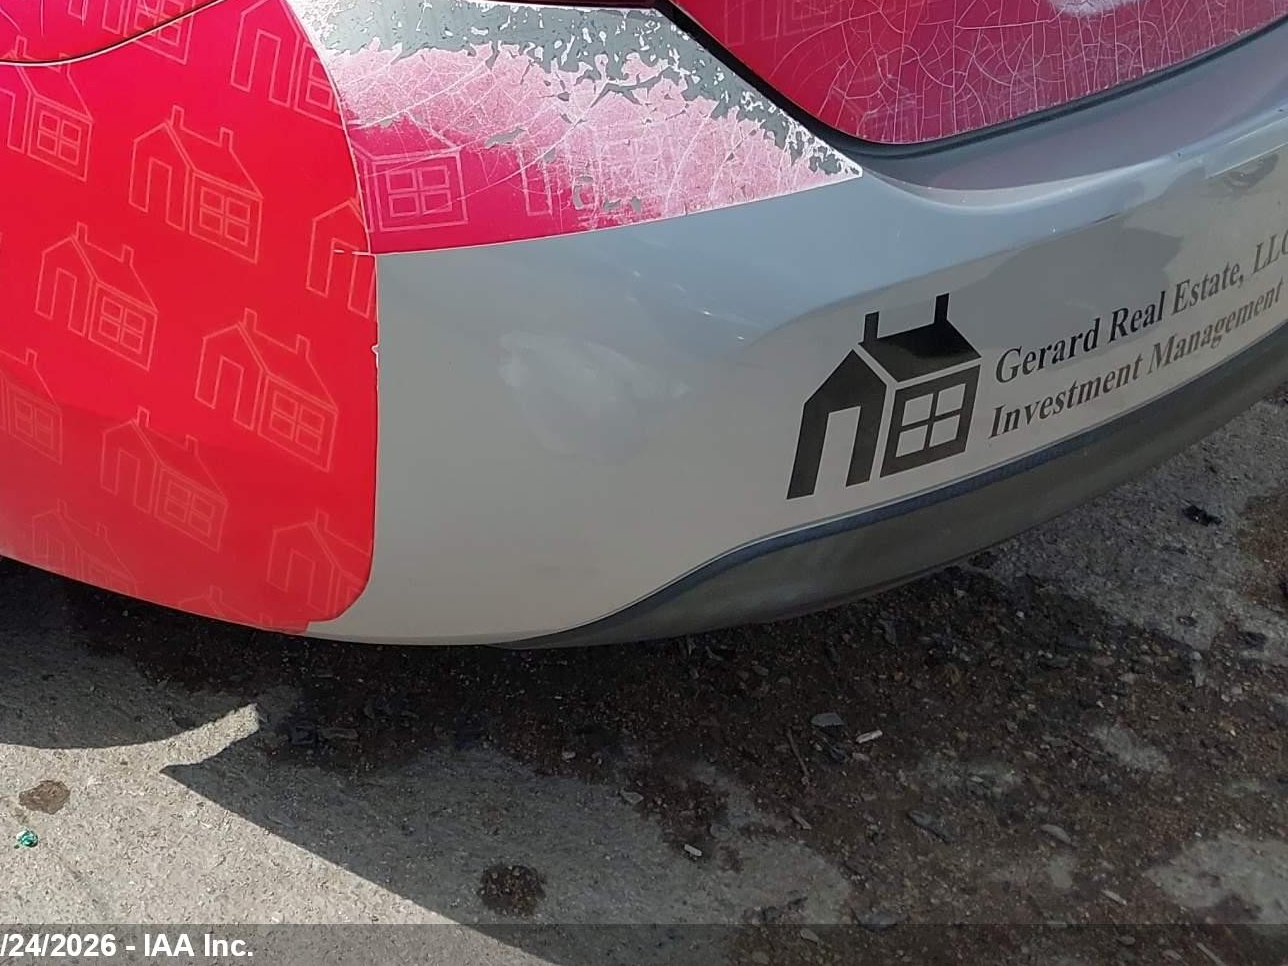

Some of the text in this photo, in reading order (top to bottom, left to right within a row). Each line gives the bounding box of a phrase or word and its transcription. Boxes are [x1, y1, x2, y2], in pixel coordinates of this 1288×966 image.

[988, 276, 1285, 440] Investment Management
[994, 318, 1101, 385] Gerard
[1108, 290, 1166, 344] Real
[1170, 261, 1245, 317] Estate,
